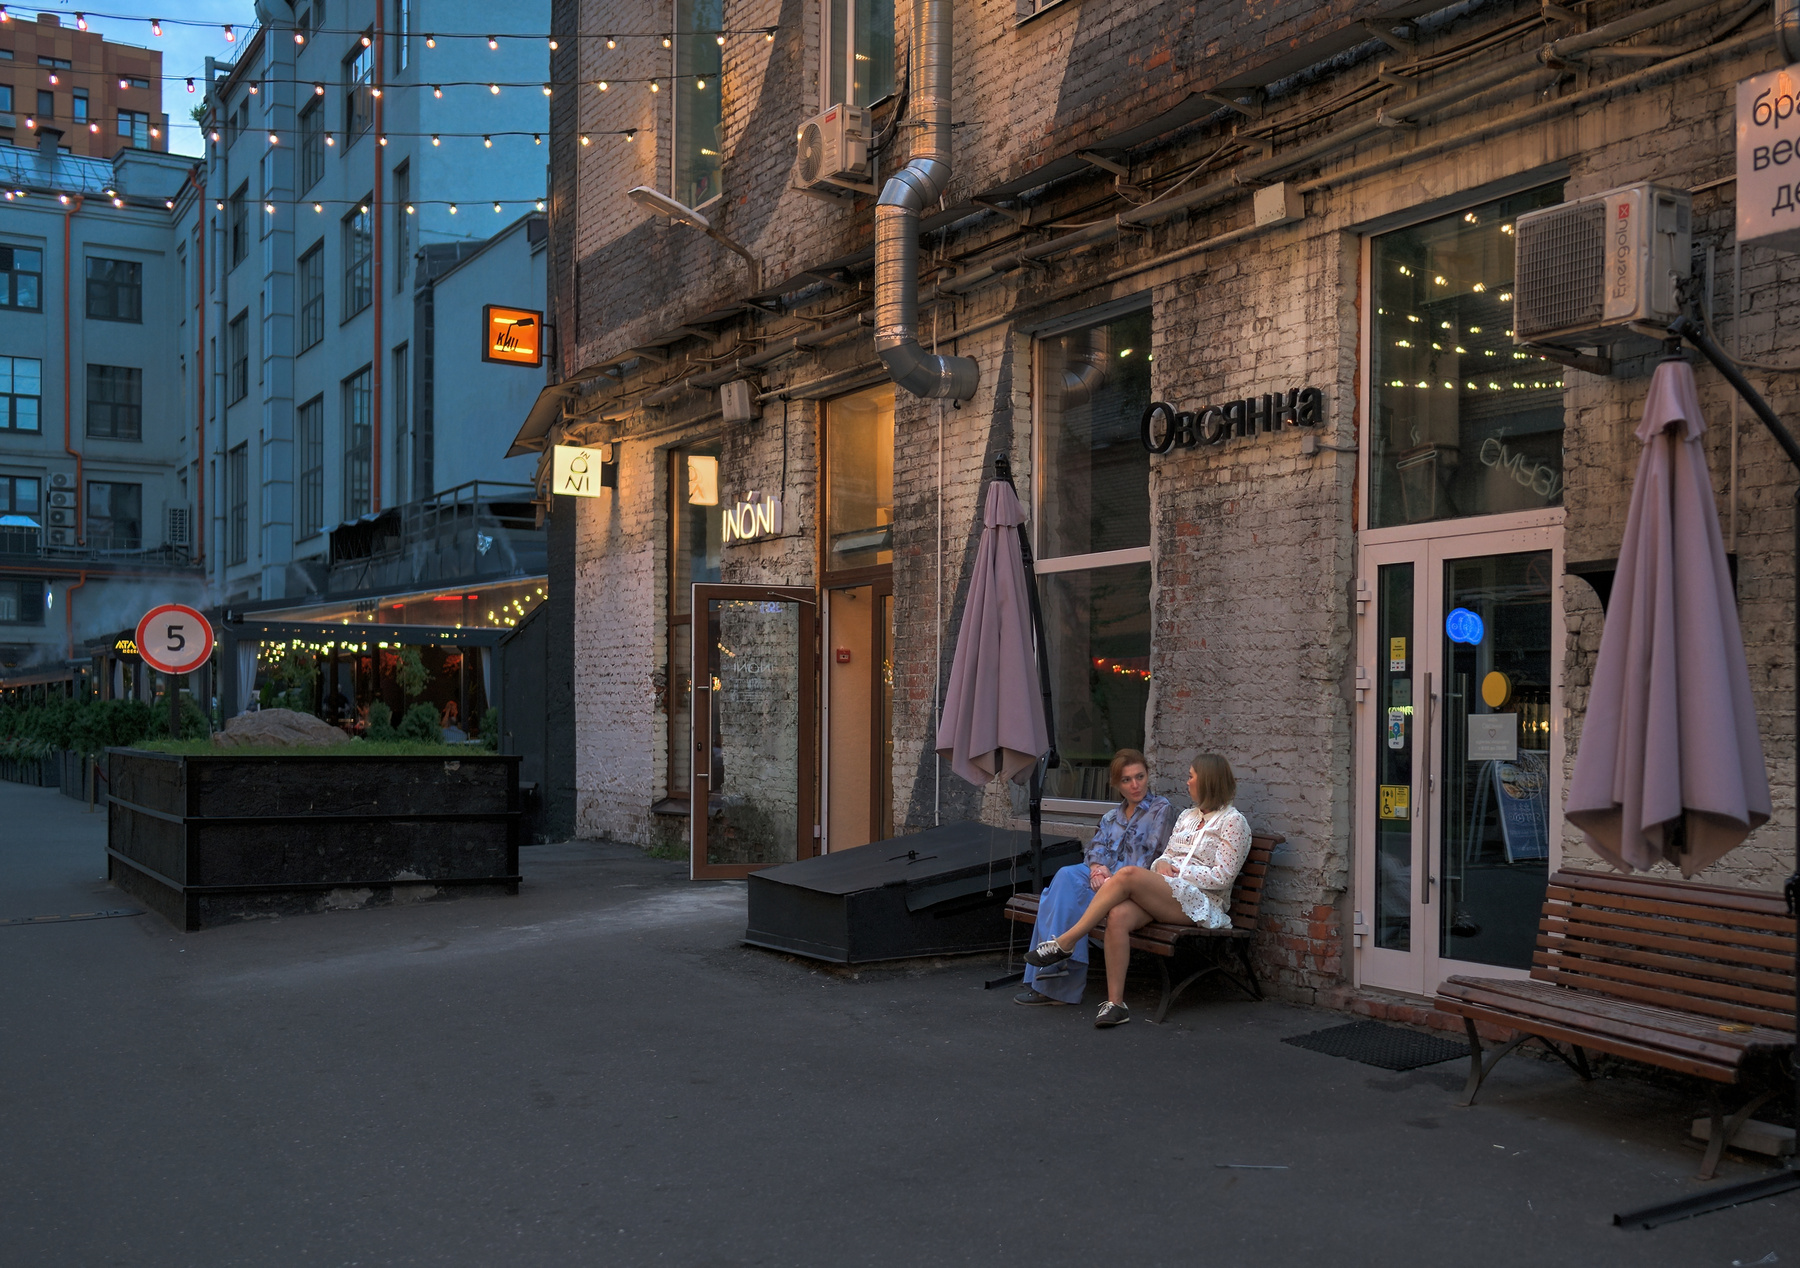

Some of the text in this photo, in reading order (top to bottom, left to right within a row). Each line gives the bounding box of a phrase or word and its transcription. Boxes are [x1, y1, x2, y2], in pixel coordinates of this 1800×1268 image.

[1753, 88, 1800, 129] бр
[1612, 203, 1631, 299] Energolux
[1141, 388, 1322, 454] Овсянка
[167, 625, 185, 651] 5
